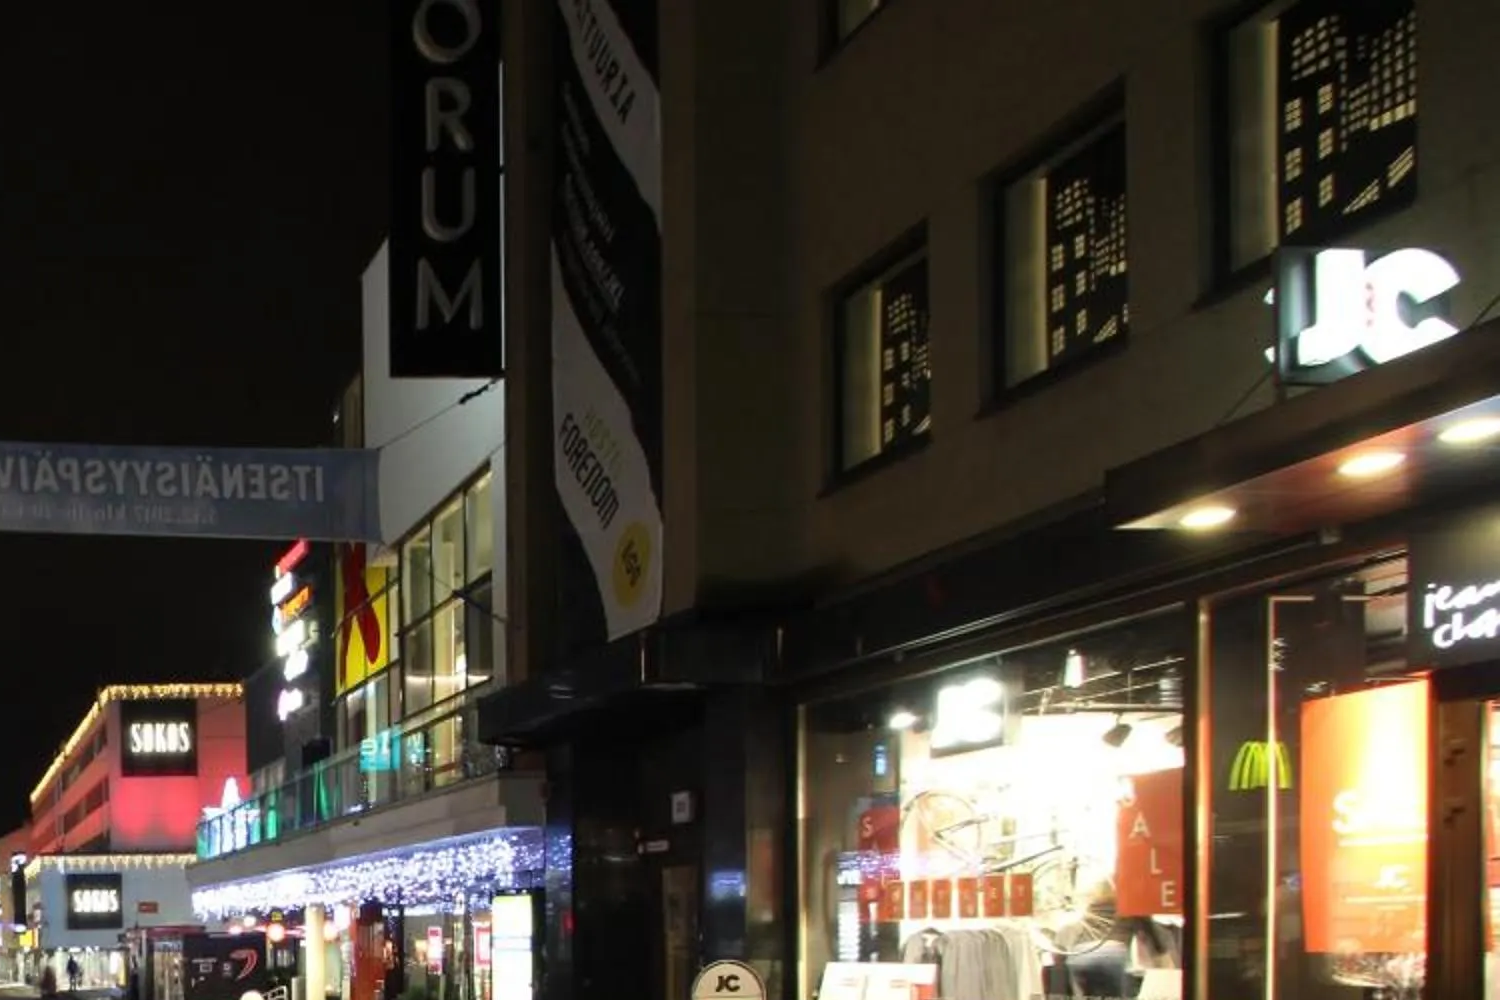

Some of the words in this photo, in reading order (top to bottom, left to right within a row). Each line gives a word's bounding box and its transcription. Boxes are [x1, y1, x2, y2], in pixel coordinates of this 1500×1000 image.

[1298, 248, 1461, 365] JC
[130, 722, 191, 753] SOKOS
[73, 888, 120, 913] SOKOS
[715, 974, 741, 992] JC
